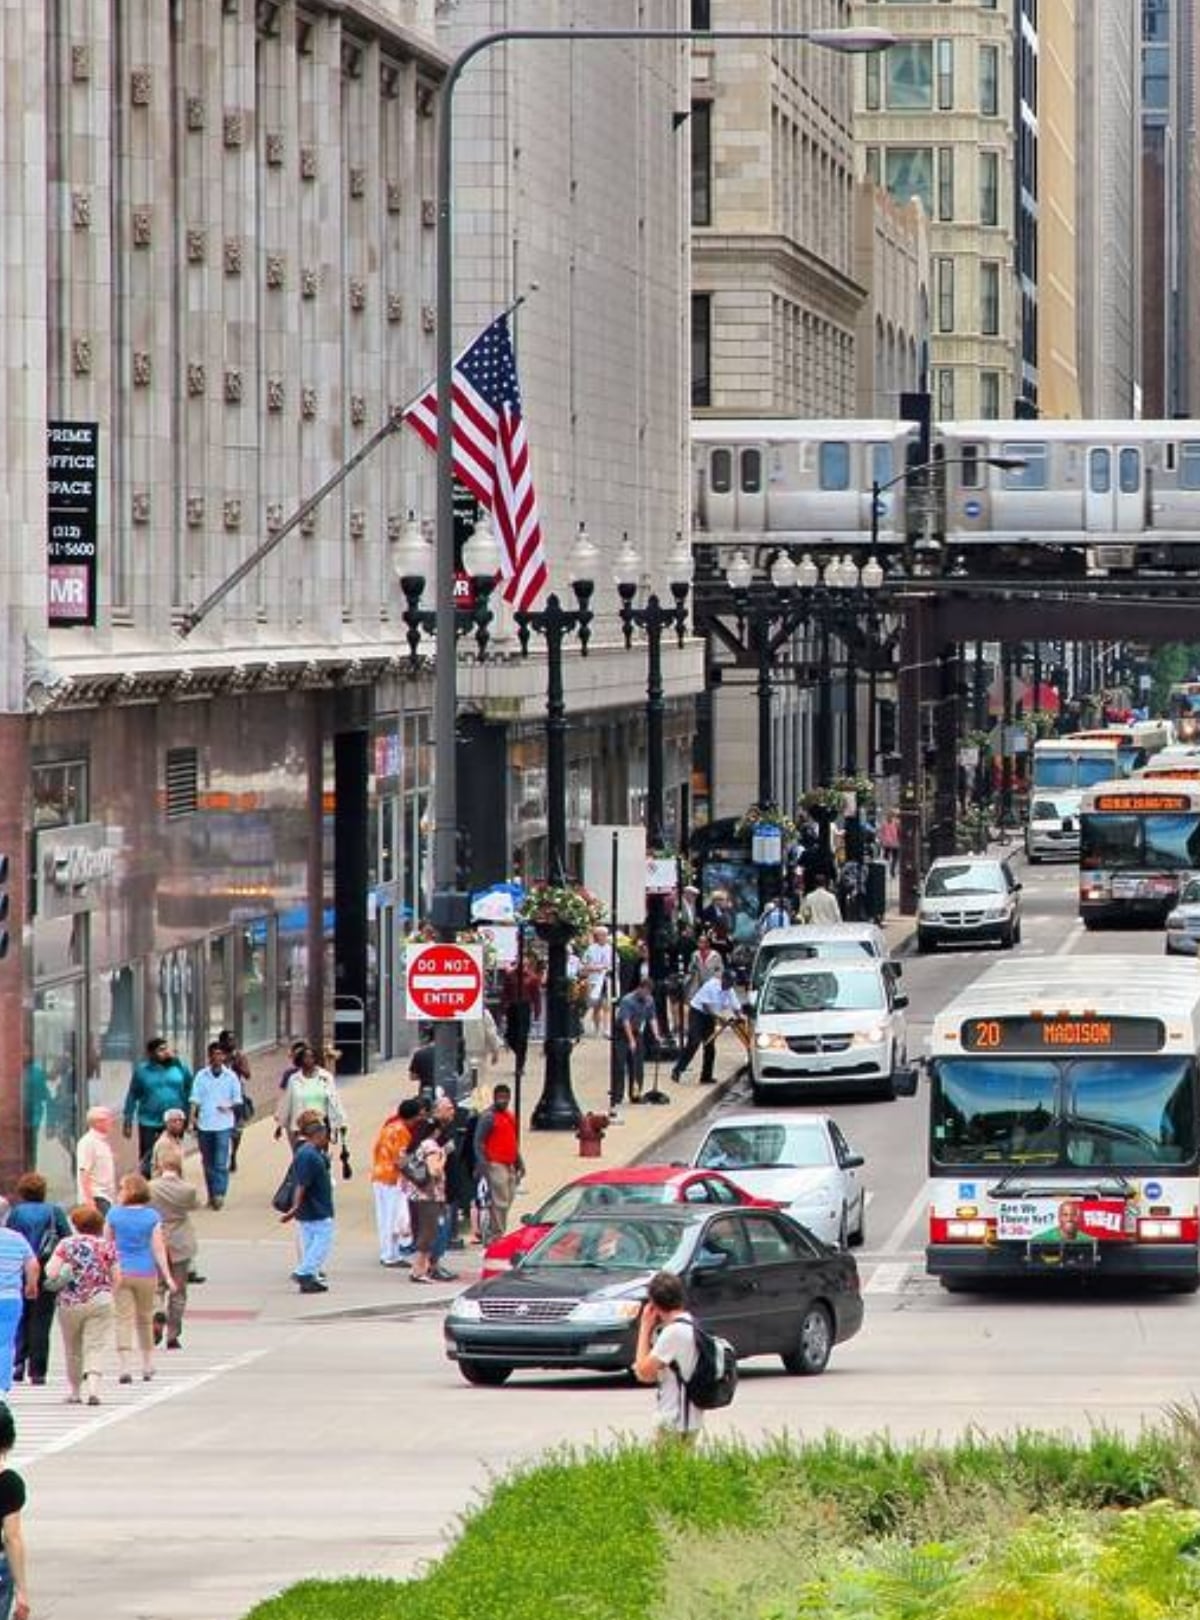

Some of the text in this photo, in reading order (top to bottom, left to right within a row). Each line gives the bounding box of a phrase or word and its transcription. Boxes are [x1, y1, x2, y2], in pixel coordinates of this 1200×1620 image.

[417, 958, 471, 972] DO NOT
[422, 991, 466, 1005] ENTER
[976, 1021, 1112, 1047] 20 MADISON
